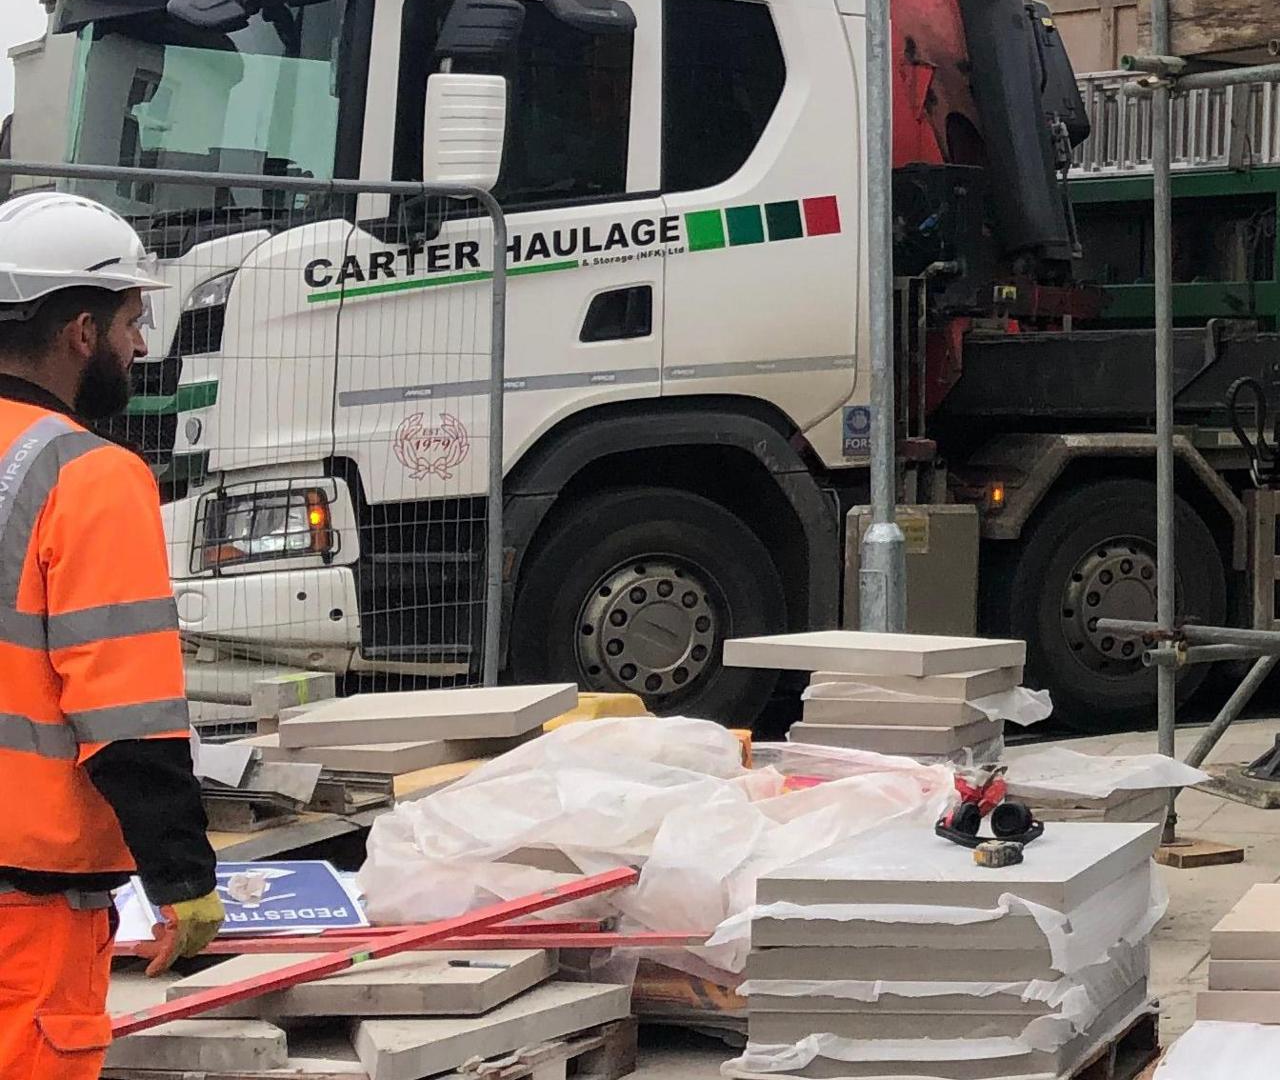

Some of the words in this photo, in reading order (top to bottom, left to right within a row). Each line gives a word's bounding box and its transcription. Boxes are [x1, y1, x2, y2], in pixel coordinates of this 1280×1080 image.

[303, 240, 481, 288] CARTER
[582, 259, 589, 267] &
[593, 253, 633, 266] Storage
[668, 246, 684, 255] Ltd
[415, 438, 451, 452] 1979
